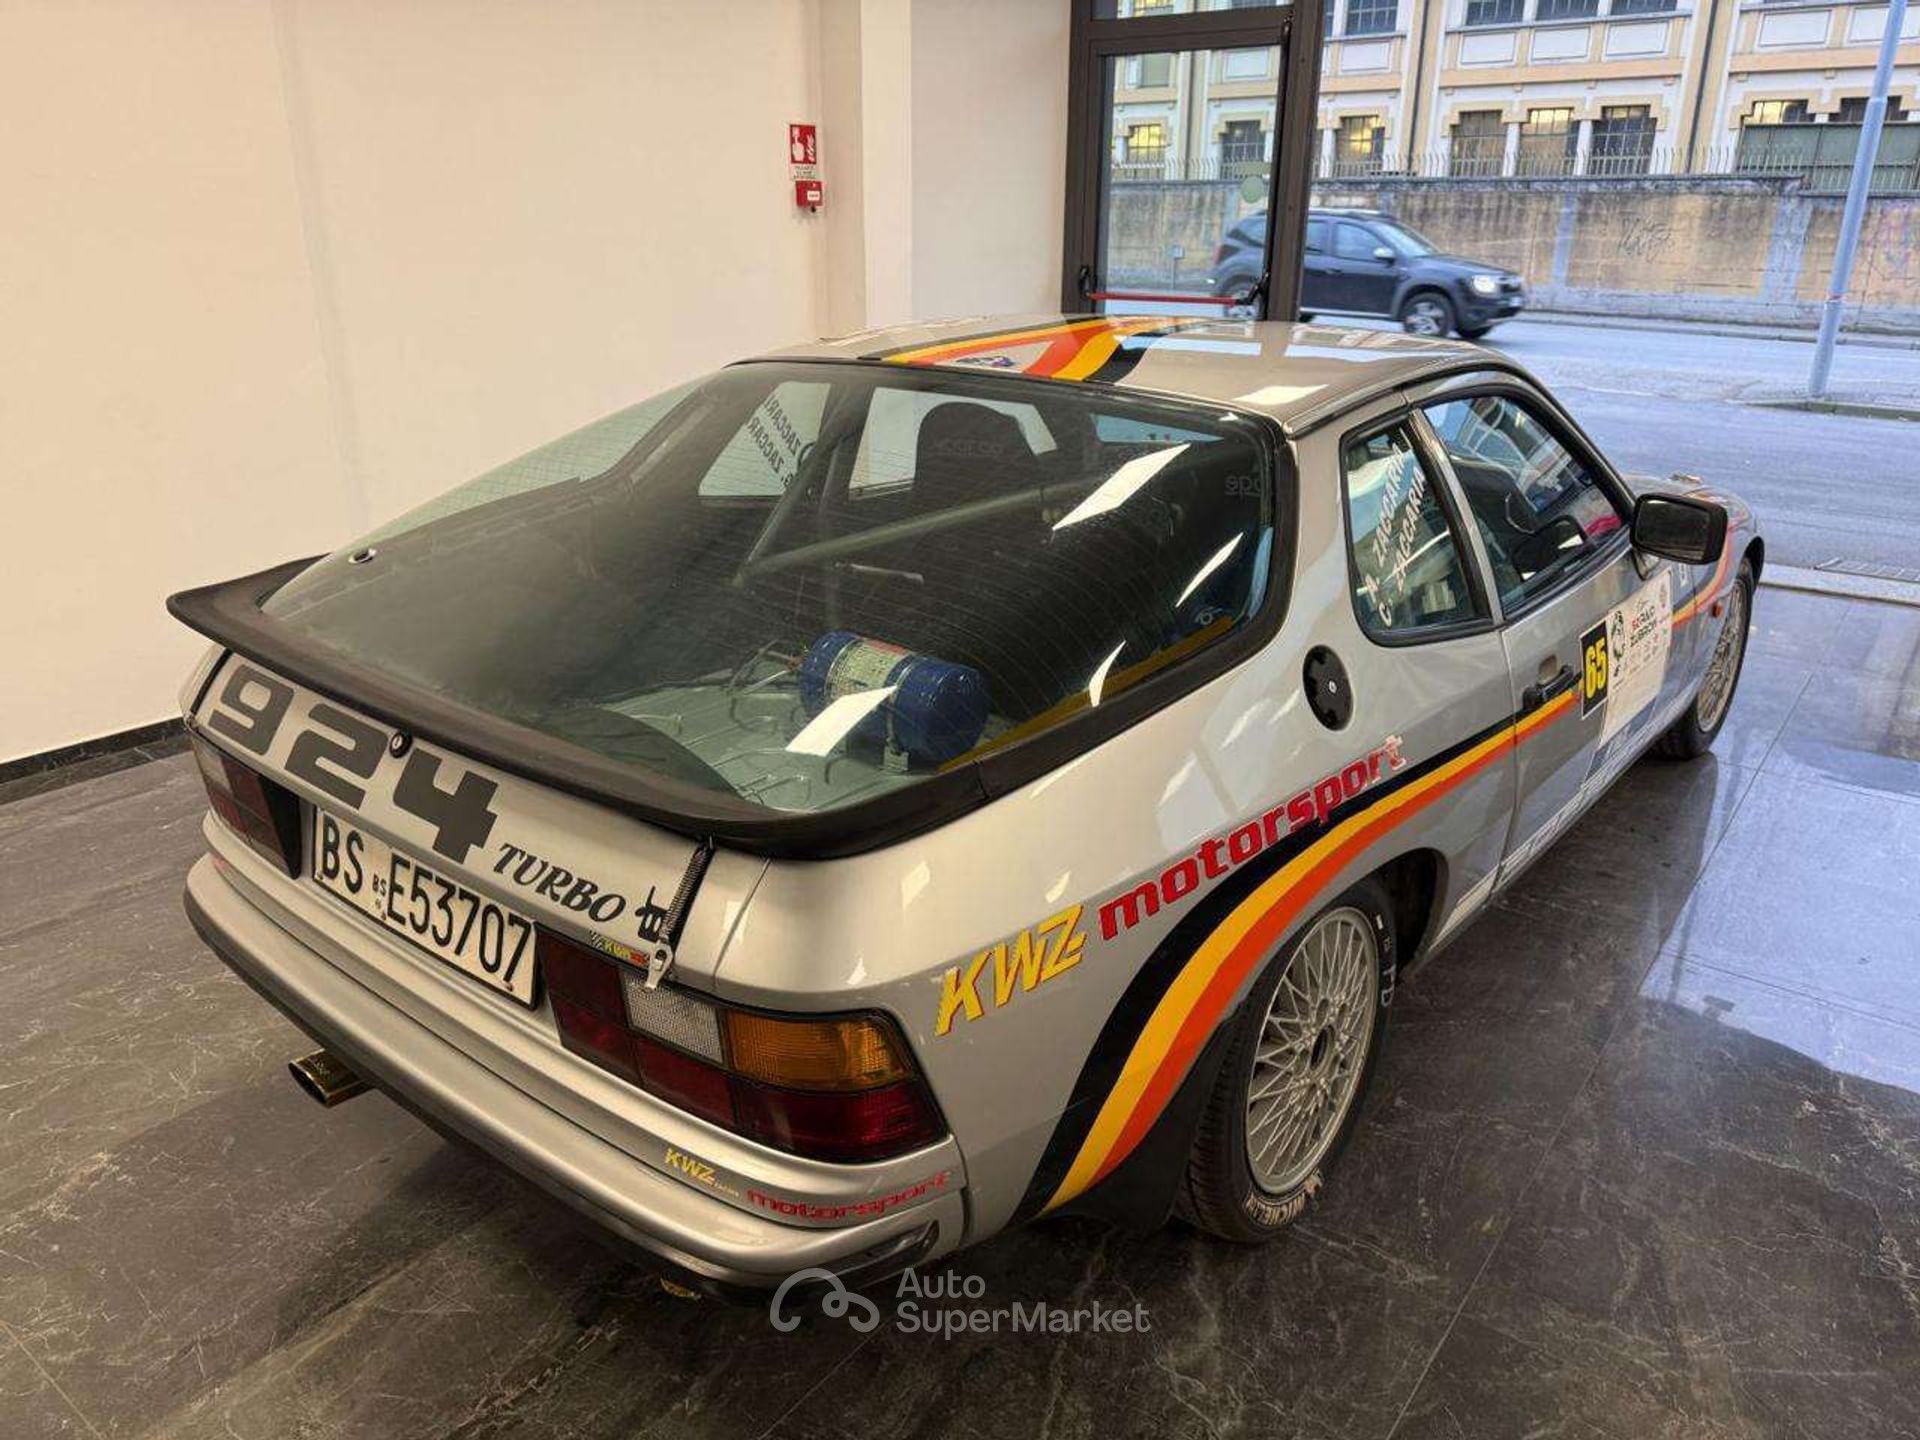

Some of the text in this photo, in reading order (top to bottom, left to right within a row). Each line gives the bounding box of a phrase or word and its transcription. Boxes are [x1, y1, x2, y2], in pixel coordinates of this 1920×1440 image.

[1585, 636, 1608, 699] 65
[208, 663, 499, 865] 924
[322, 812, 533, 986] BS E53707
[493, 842, 627, 923] TURBO
[1097, 734, 1409, 943] motorsport
[745, 1170, 951, 1221] motorsport
